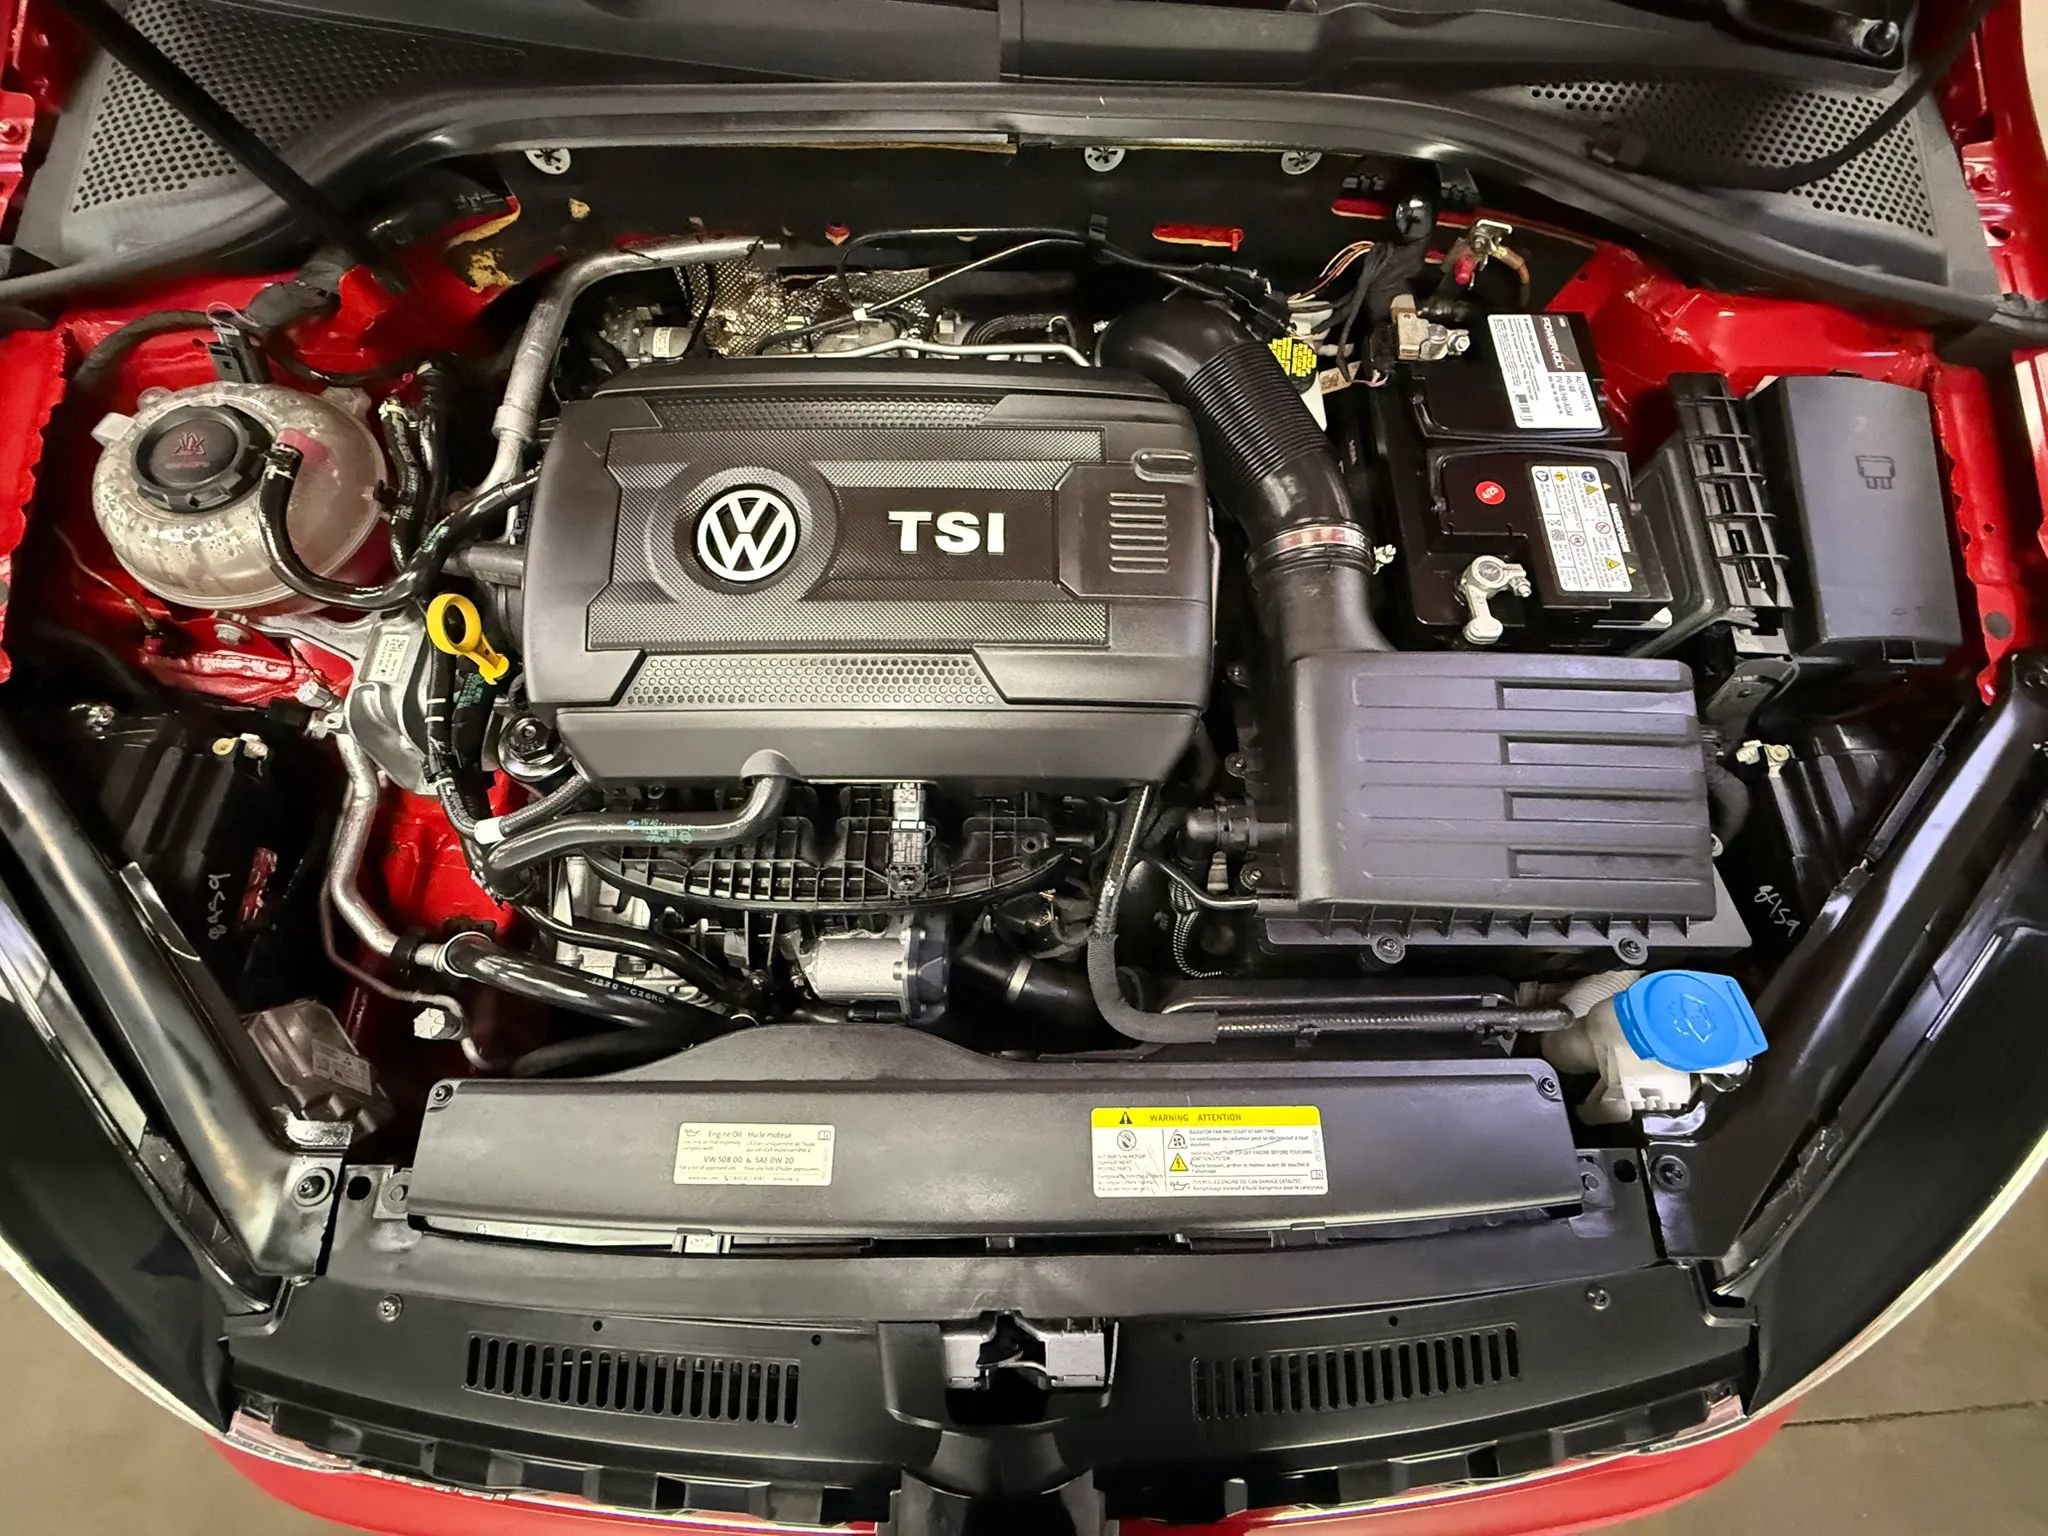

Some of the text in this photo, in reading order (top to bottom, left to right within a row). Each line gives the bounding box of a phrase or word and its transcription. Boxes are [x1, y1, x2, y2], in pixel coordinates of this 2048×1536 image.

[1542, 317, 1566, 371] POWERVOLT
[1576, 375, 1593, 412] AUTOMOTIVE
[888, 511, 1005, 555] TSI
[767, 1131, 793, 1139] moteur
[1149, 1113, 1242, 1122] WARNING ATTENTION
